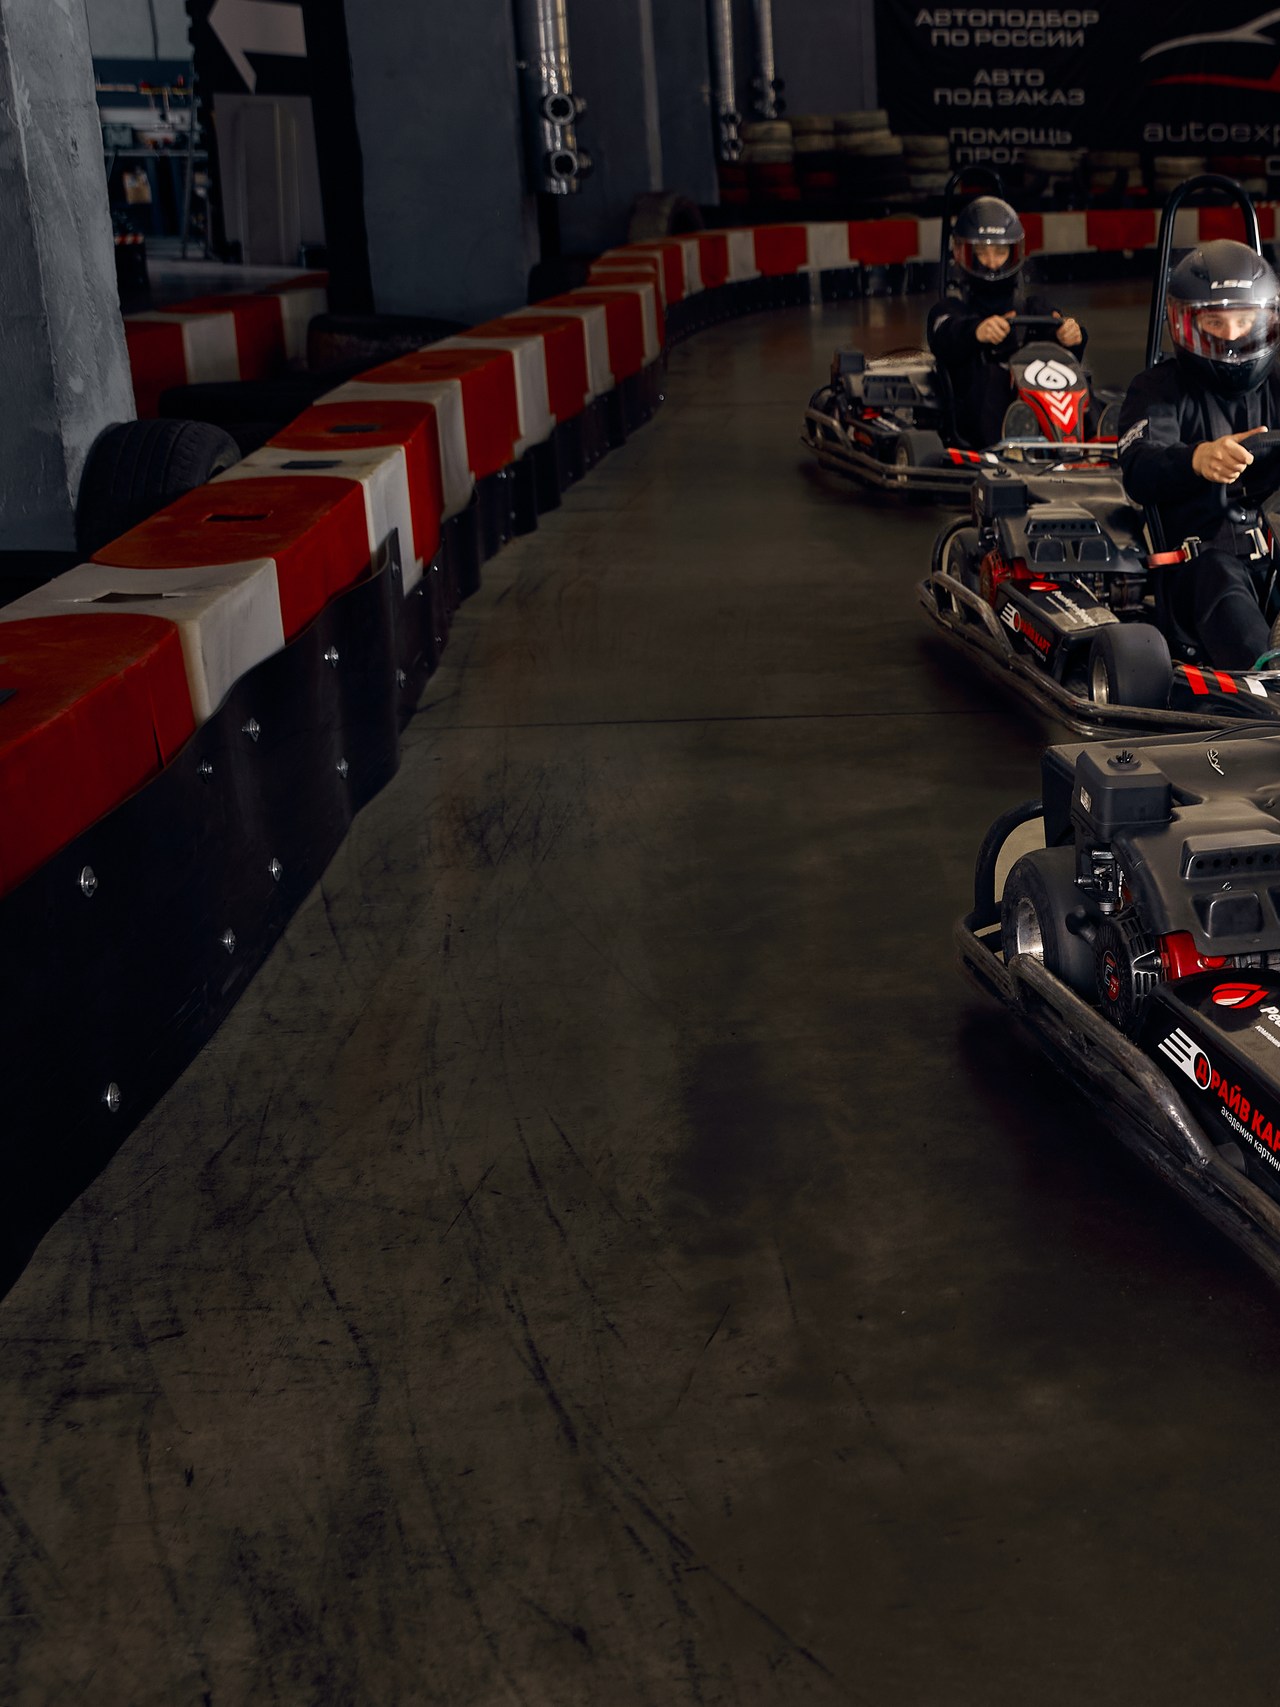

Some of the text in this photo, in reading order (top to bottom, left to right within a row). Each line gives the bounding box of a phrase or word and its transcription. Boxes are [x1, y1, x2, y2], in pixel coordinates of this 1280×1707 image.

[915, 8, 1100, 29] АВТОПОДБОР
[931, 29, 1084, 47] ПО РОССИИ
[973, 69, 1045, 86] АВТО
[933, 88, 1085, 108] ПОД ЗАКАЗ
[949, 127, 1072, 146] ПОМОЩЬ
[1220, 1105, 1254, 1146] академия
